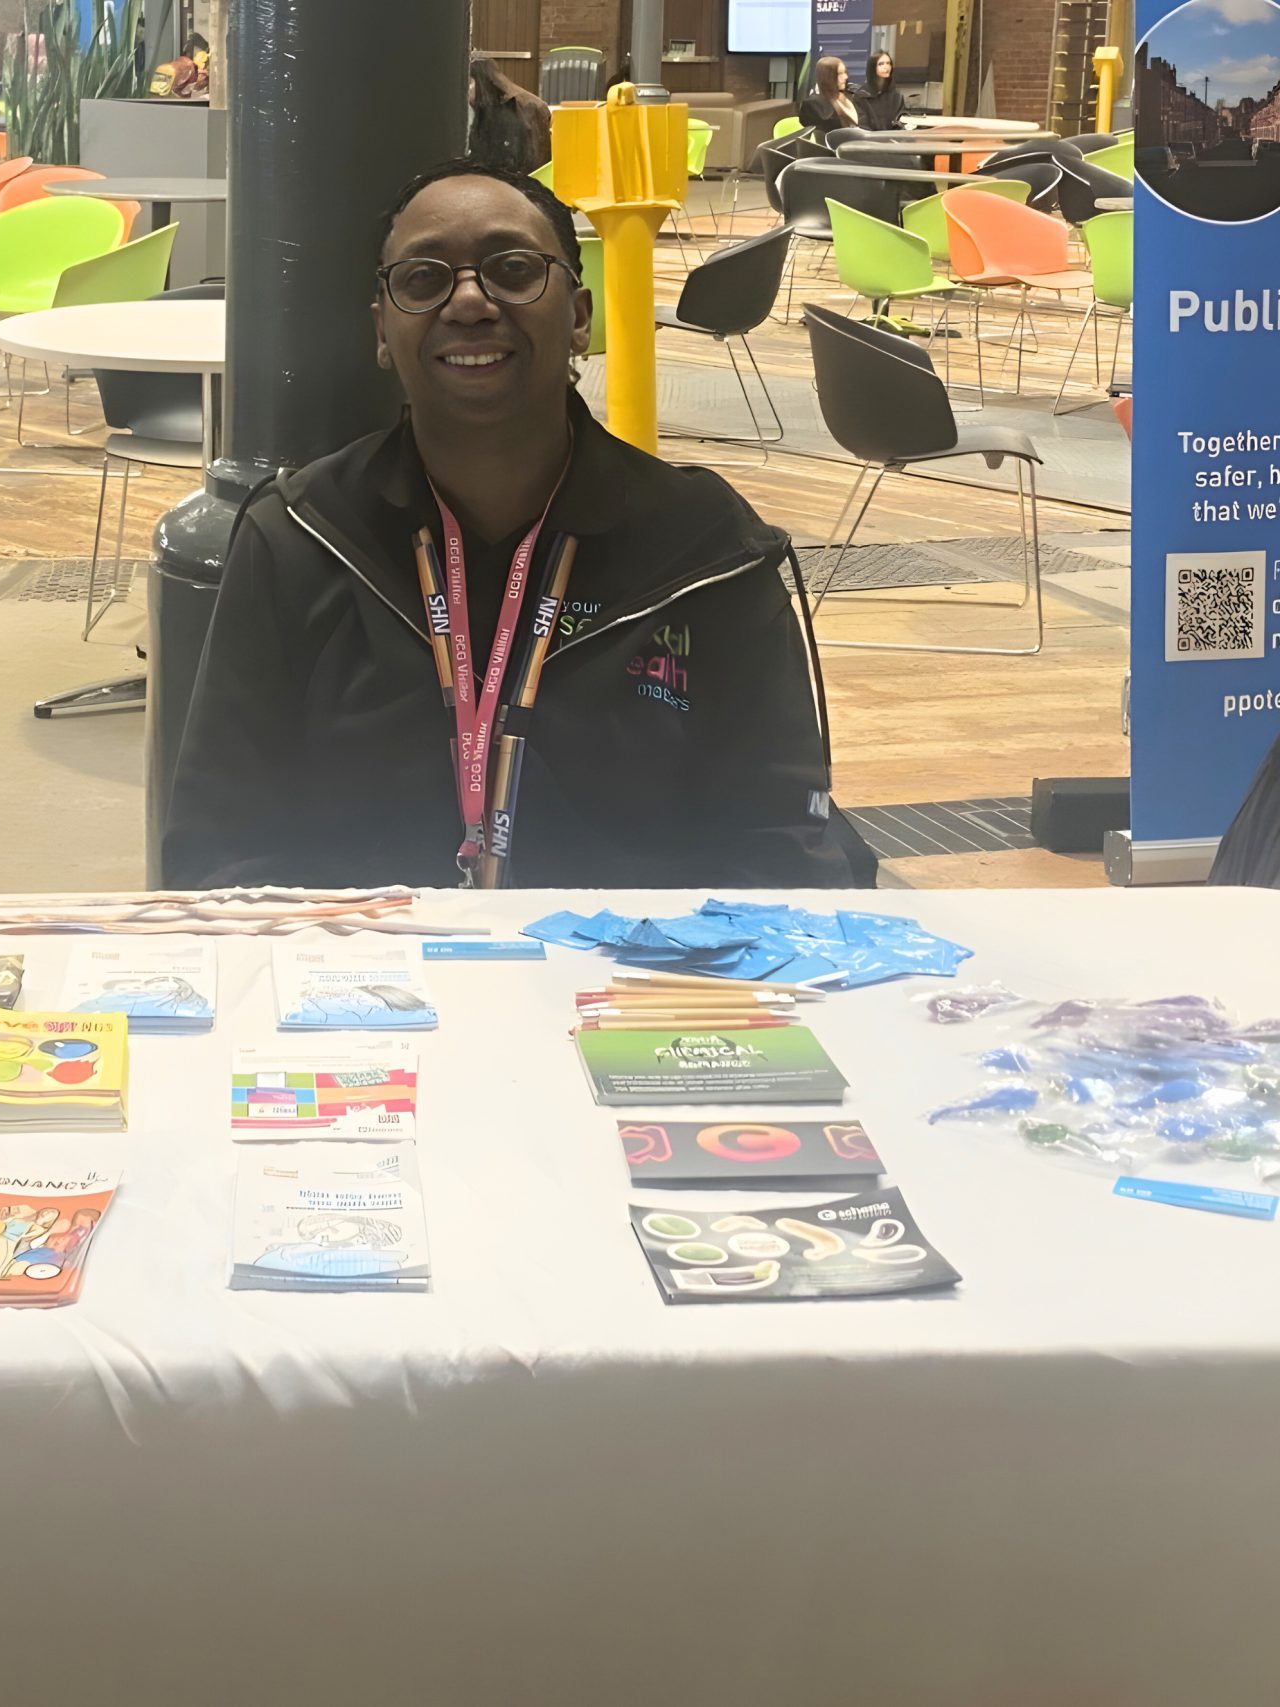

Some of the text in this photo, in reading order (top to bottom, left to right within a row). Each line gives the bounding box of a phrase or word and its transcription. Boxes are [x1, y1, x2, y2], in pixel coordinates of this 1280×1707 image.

[1177, 429, 1280, 458] Together
[1195, 464, 1262, 489] safer,
[1192, 499, 1240, 522] that
[428, 593, 451, 636] NHS
[533, 595, 559, 637] NHS
[490, 811, 511, 858] NHS
